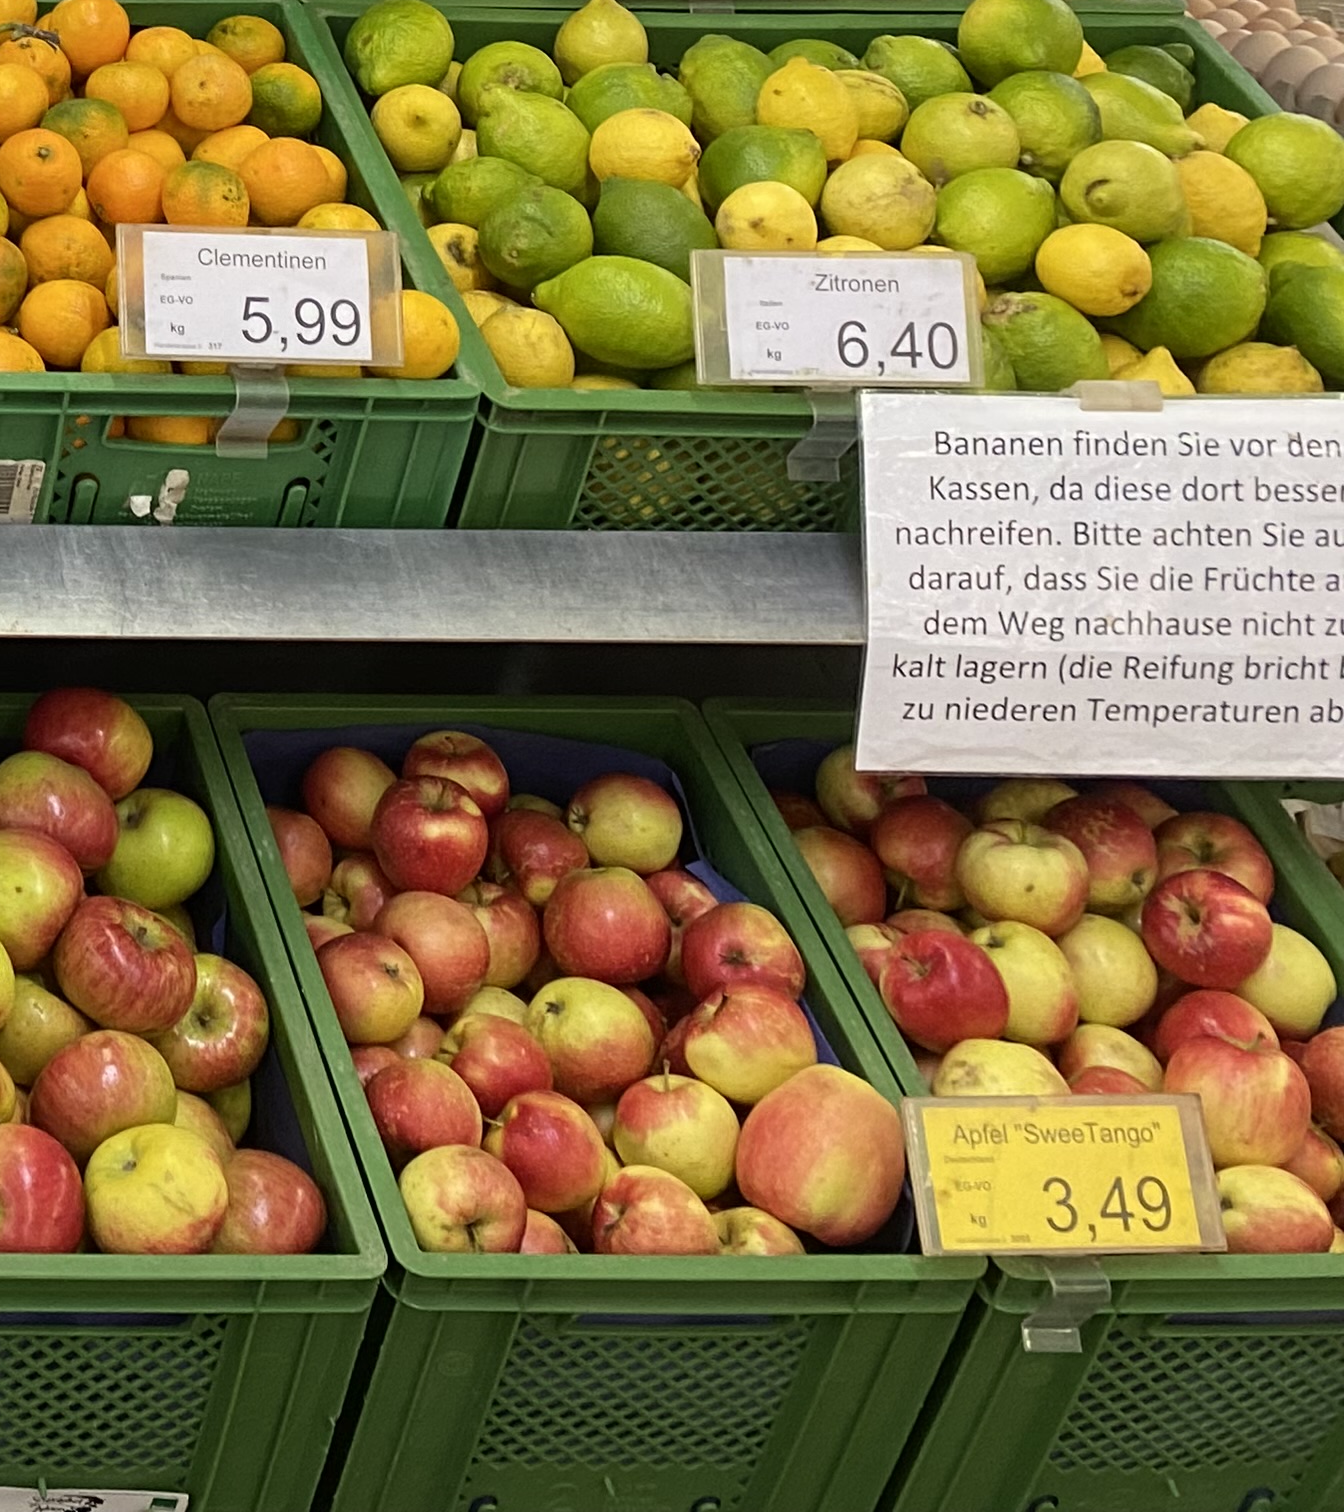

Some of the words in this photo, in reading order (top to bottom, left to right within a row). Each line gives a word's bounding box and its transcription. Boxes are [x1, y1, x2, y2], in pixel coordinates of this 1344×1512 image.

[197, 247, 327, 270] Clementinen
[814, 273, 900, 293] Zitronen
[160, 295, 194, 305] EG-VO
[170, 322, 186, 335] kg
[241, 296, 361, 352] 5,99
[755, 320, 790, 331] EG-VO
[766, 348, 782, 361] kg
[837, 320, 959, 376] 6,40
[934, 430, 1064, 459] Bananen
[1073, 430, 1168, 459] finden
[1177, 430, 1220, 459] Sie
[1230, 438, 1276, 459] vor
[1287, 432, 1342, 459] den
[929, 475, 1040, 506] Kassen,
[1048, 476, 1083, 503] da
[1093, 476, 1172, 503] diese
[1181, 477, 1245, 503] dort
[895, 520, 1062, 547] nachreifen.
[1072, 521, 1142, 547] Bitte
[1152, 521, 1252, 548] achten
[1262, 522, 1305, 548] Sie
[908, 565, 1012, 595] darauf,
[1023, 565, 1086, 591] dass
[1096, 566, 1139, 592] Sie
[1149, 566, 1194, 592] die
[1204, 566, 1315, 592] Früchte
[923, 609, 987, 636] dem
[997, 610, 1065, 642] Weg
[1074, 610, 1232, 637] nachhause
[1242, 611, 1315, 637] nicht
[892, 653, 946, 679] kalt
[955, 653, 1048, 685] lagern
[1058, 654, 1113, 685] (die
[1123, 655, 1234, 686] Reifung
[1244, 655, 1329, 682] bricht
[902, 702, 934, 721] zu
[945, 697, 1077, 723] niederen
[1086, 698, 1300, 729] Temperaturen
[953, 1124, 1009, 1149] Apfel
[1014, 1121, 1161, 1147] "SweeTango"
[970, 1213, 987, 1228] kg
[1041, 1175, 1172, 1242] 3,49
